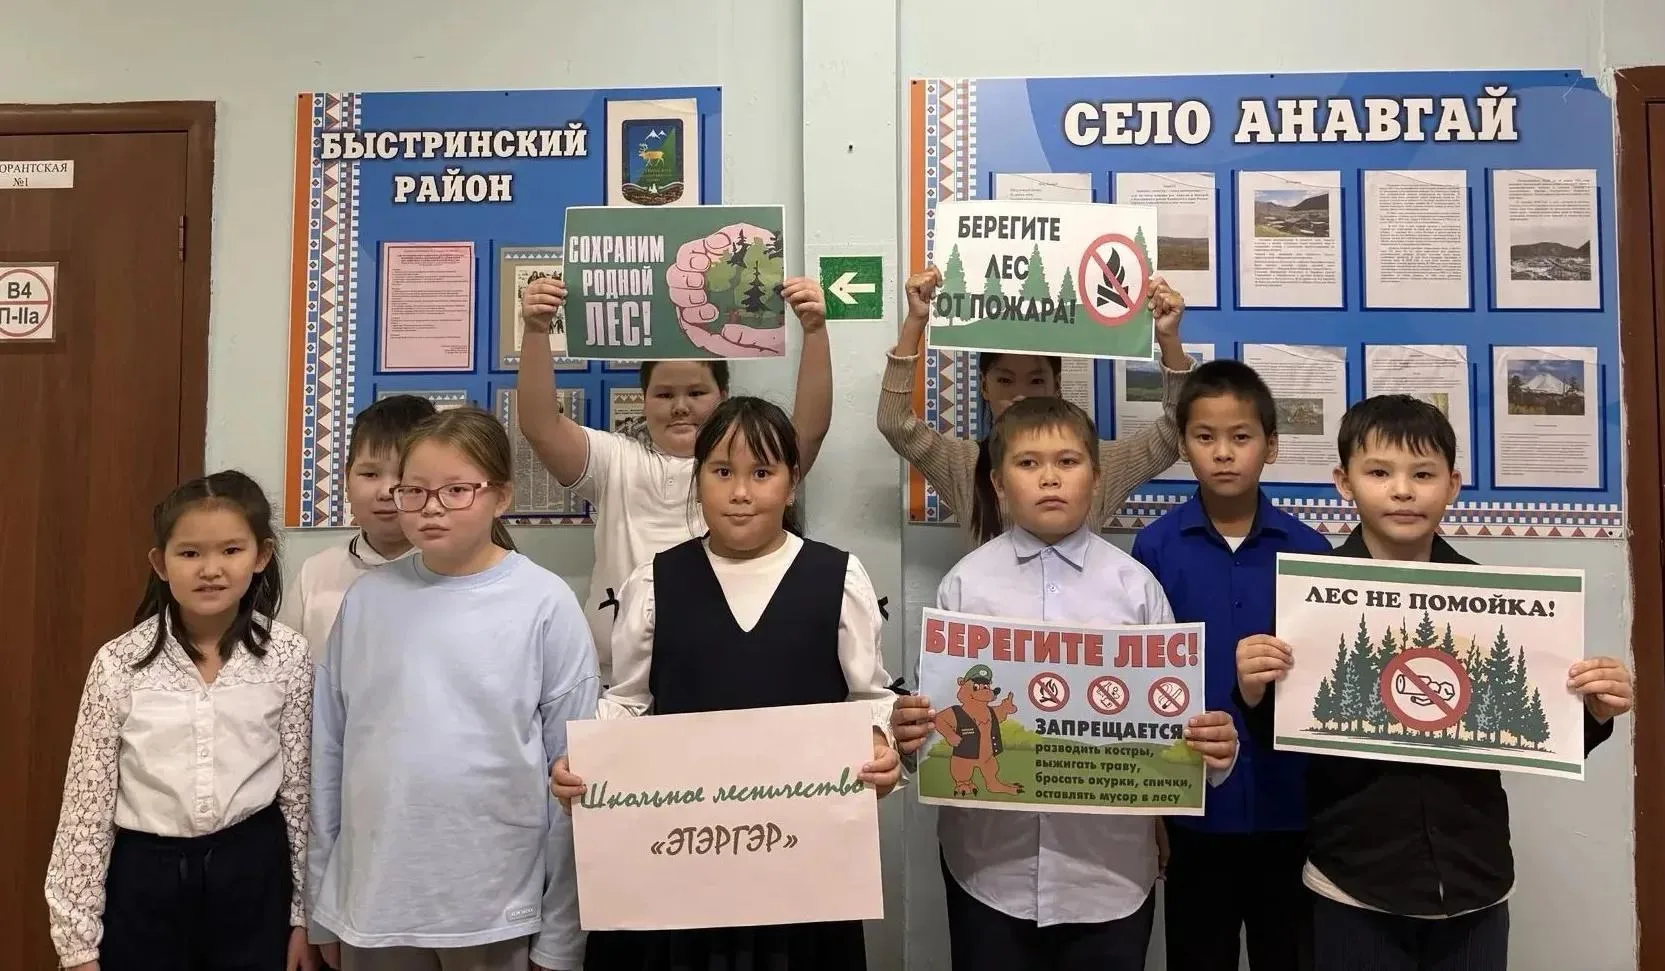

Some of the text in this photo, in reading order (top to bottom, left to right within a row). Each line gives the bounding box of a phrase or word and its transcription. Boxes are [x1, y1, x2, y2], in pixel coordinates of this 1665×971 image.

[1063, 86, 1519, 146] СЕЛО АНАВГАЙ
[320, 122, 588, 160] БЫСТРИНСКИЙ
[12, 177, 28, 187] №1
[394, 168, 513, 203] РАЙОН
[958, 215, 1061, 242] БЕРЕГИТЕ
[569, 235, 665, 263] СОХРАНИМ
[582, 265, 654, 299] РОДНОЙ
[985, 253, 1029, 280] ЛЕС
[585, 301, 653, 347] ЛЕС!
[936, 292, 1077, 325] ОТ ПОЖАРА!
[1305, 586, 1556, 618] ЛЕС НЕ ПОМОЙКА!
[925, 618, 1199, 669] БЕРЕГИТЕ ЛЕС!
[1035, 718, 1184, 741] ЗАПРЕЩАЕТСЯ
[1035, 743, 1155, 758] разводить костры,
[1035, 758, 1142, 774] выжигать траву,
[580, 766, 865, 810] Школьное лесничество
[1035, 771, 1193, 789] бросать окурки, спички,
[1035, 789, 1181, 804] оставлять мусор в лесу
[650, 822, 799, 856] «ЭТЭРГЭР»
